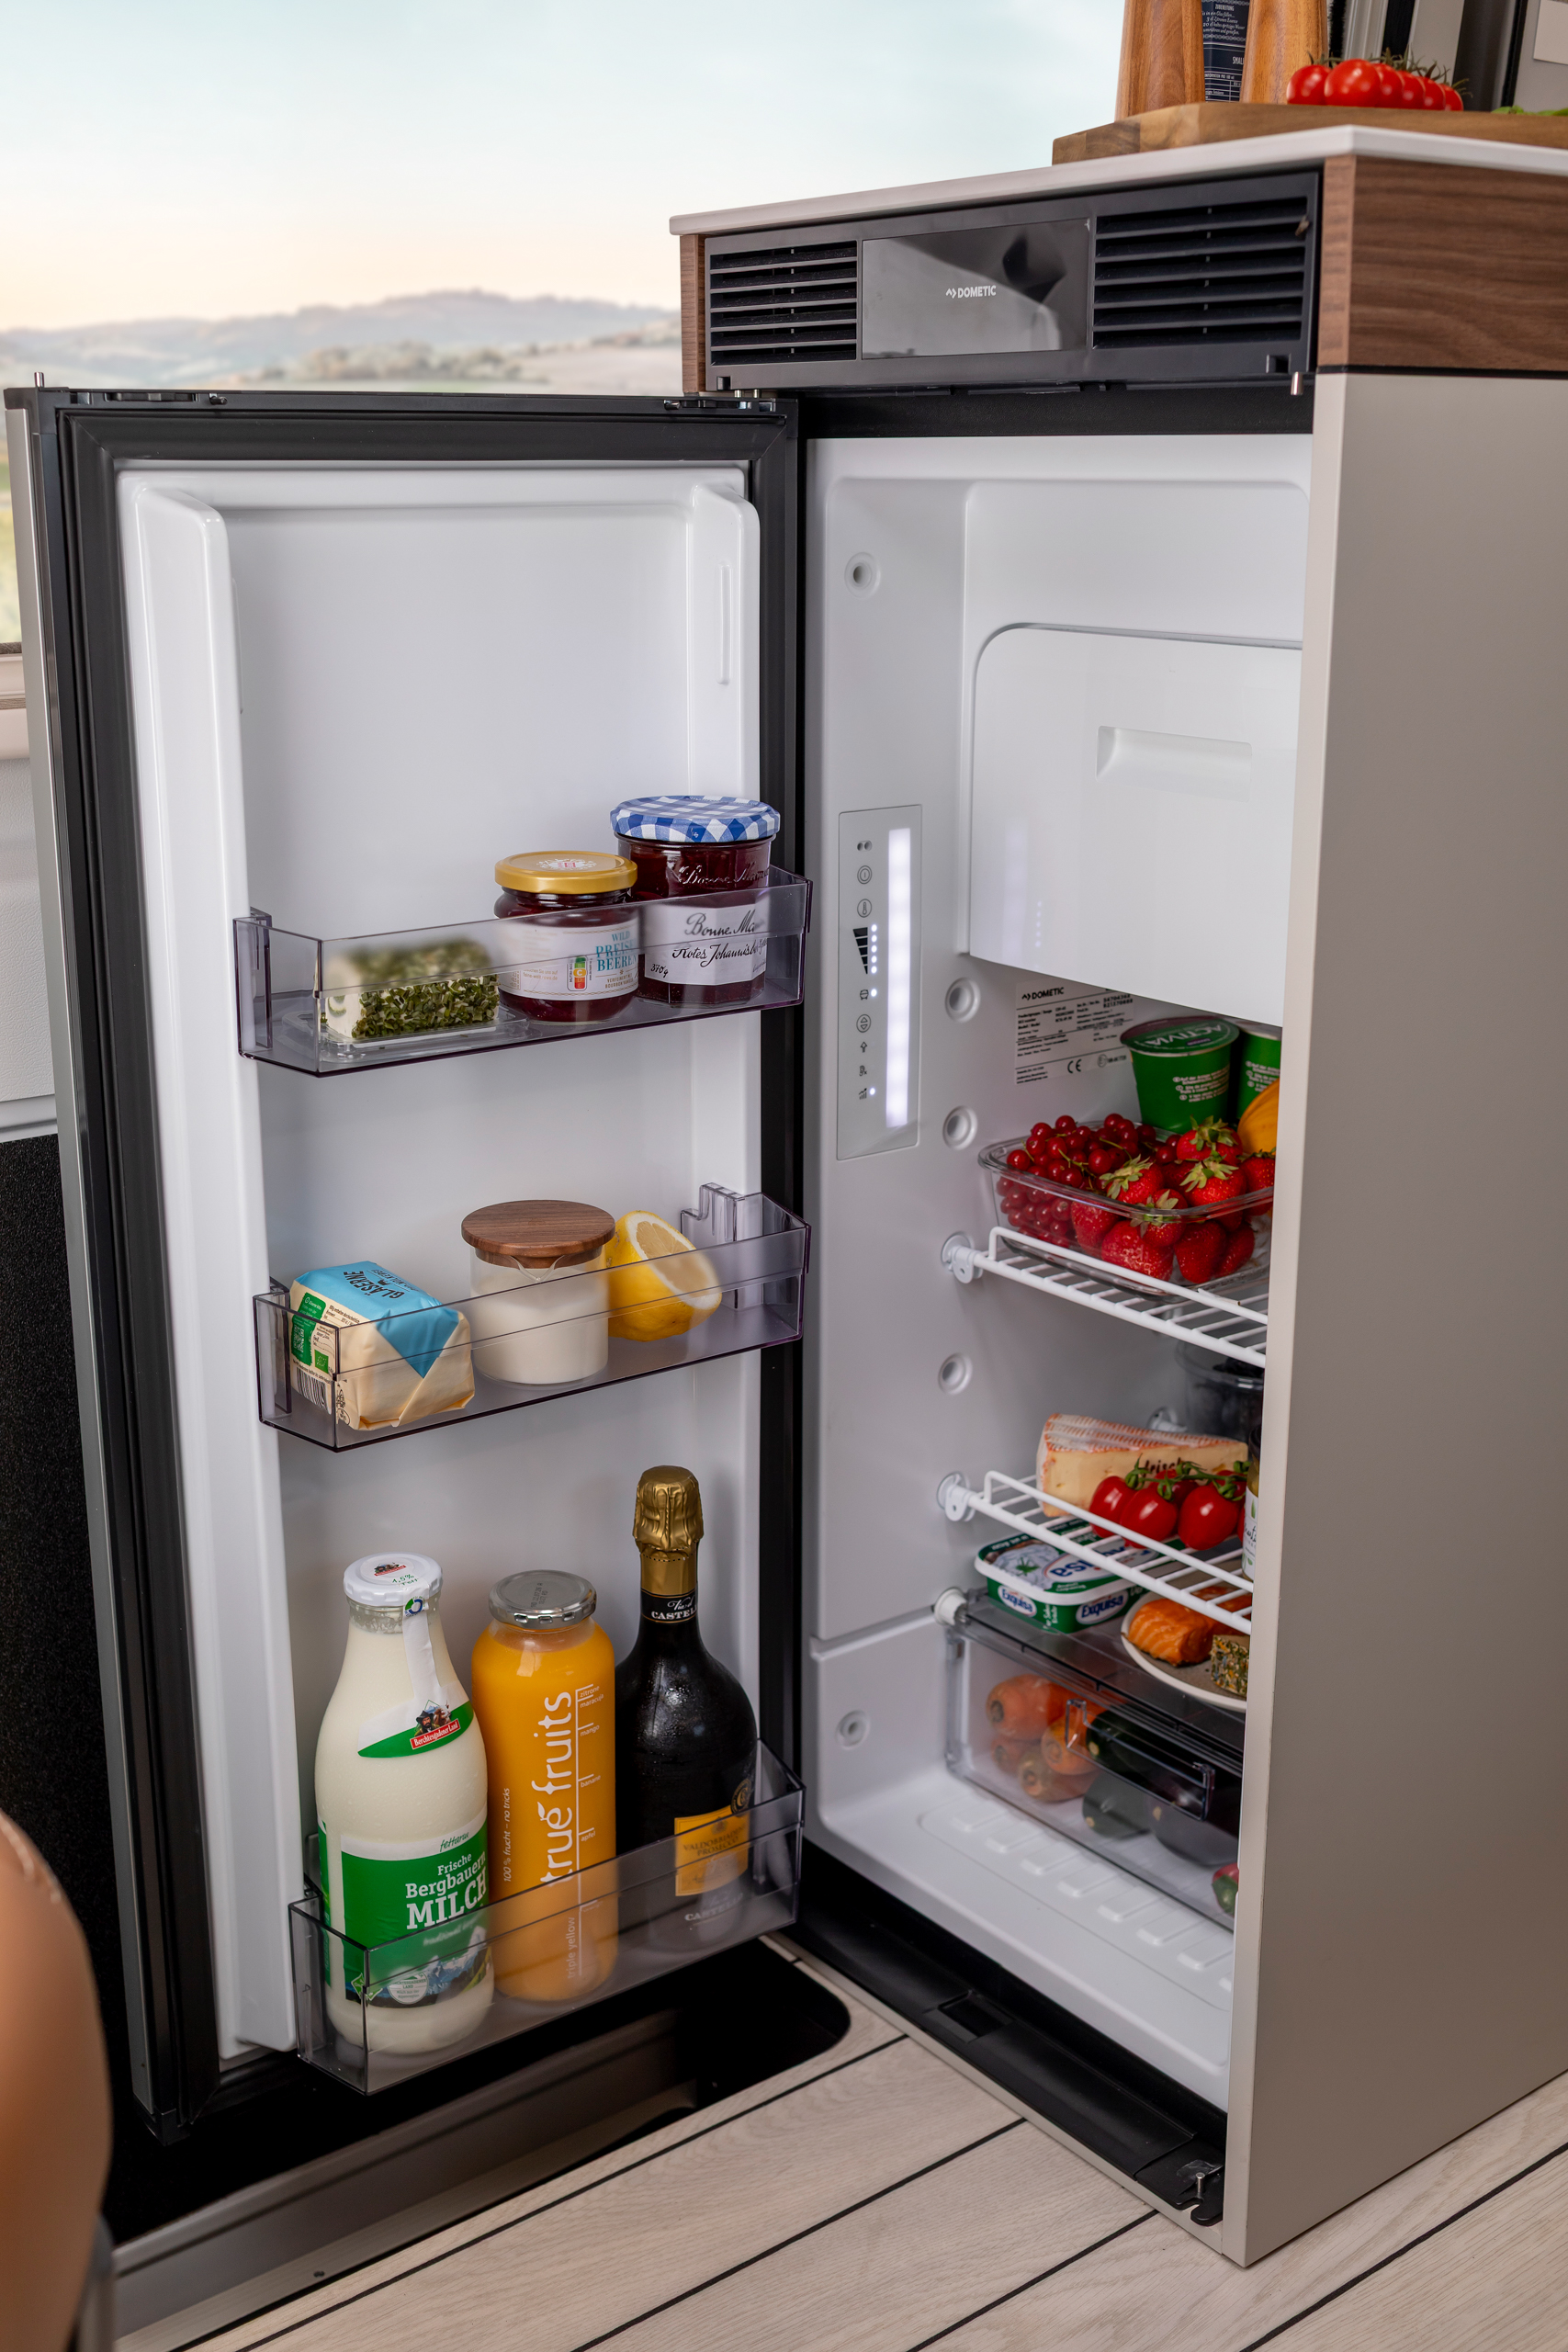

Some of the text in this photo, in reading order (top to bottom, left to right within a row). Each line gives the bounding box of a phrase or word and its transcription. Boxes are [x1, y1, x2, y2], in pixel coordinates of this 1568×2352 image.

[957, 285, 997, 299] DOMETIC
[684, 912, 732, 936] Bonne
[611, 931, 631, 942] WILD
[671, 943, 707, 959] Rotes
[597, 955, 637, 972] BEEREN
[1032, 987, 1064, 1000] DOMETIC
[1066, 1058, 1082, 1074] CE
[343, 1271, 405, 1299] GLÄSERNE
[1002, 1589, 1033, 1612] Exquisa
[1081, 1595, 1123, 1618] Exquisa
[580, 1685, 600, 1698] zitrone
[580, 1692, 604, 1709] maracuja
[413, 1721, 458, 1747] Berchtesgadener Land
[580, 1724, 600, 1736] mango
[531, 1691, 573, 1887] true fruits
[581, 1774, 602, 1788] banane
[504, 1810, 511, 1822] no
[440, 1832, 469, 1852] fettarm
[502, 1831, 511, 1856] frucht
[581, 1830, 596, 1843] apfel
[696, 1836, 739, 1857] PROSECCO
[437, 1853, 472, 1876] Frische
[405, 1850, 486, 1899] Bergbauern
[503, 1866, 512, 1883] 100
[406, 1866, 487, 1929] MILCH
[566, 1917, 578, 1979] triple yellow
